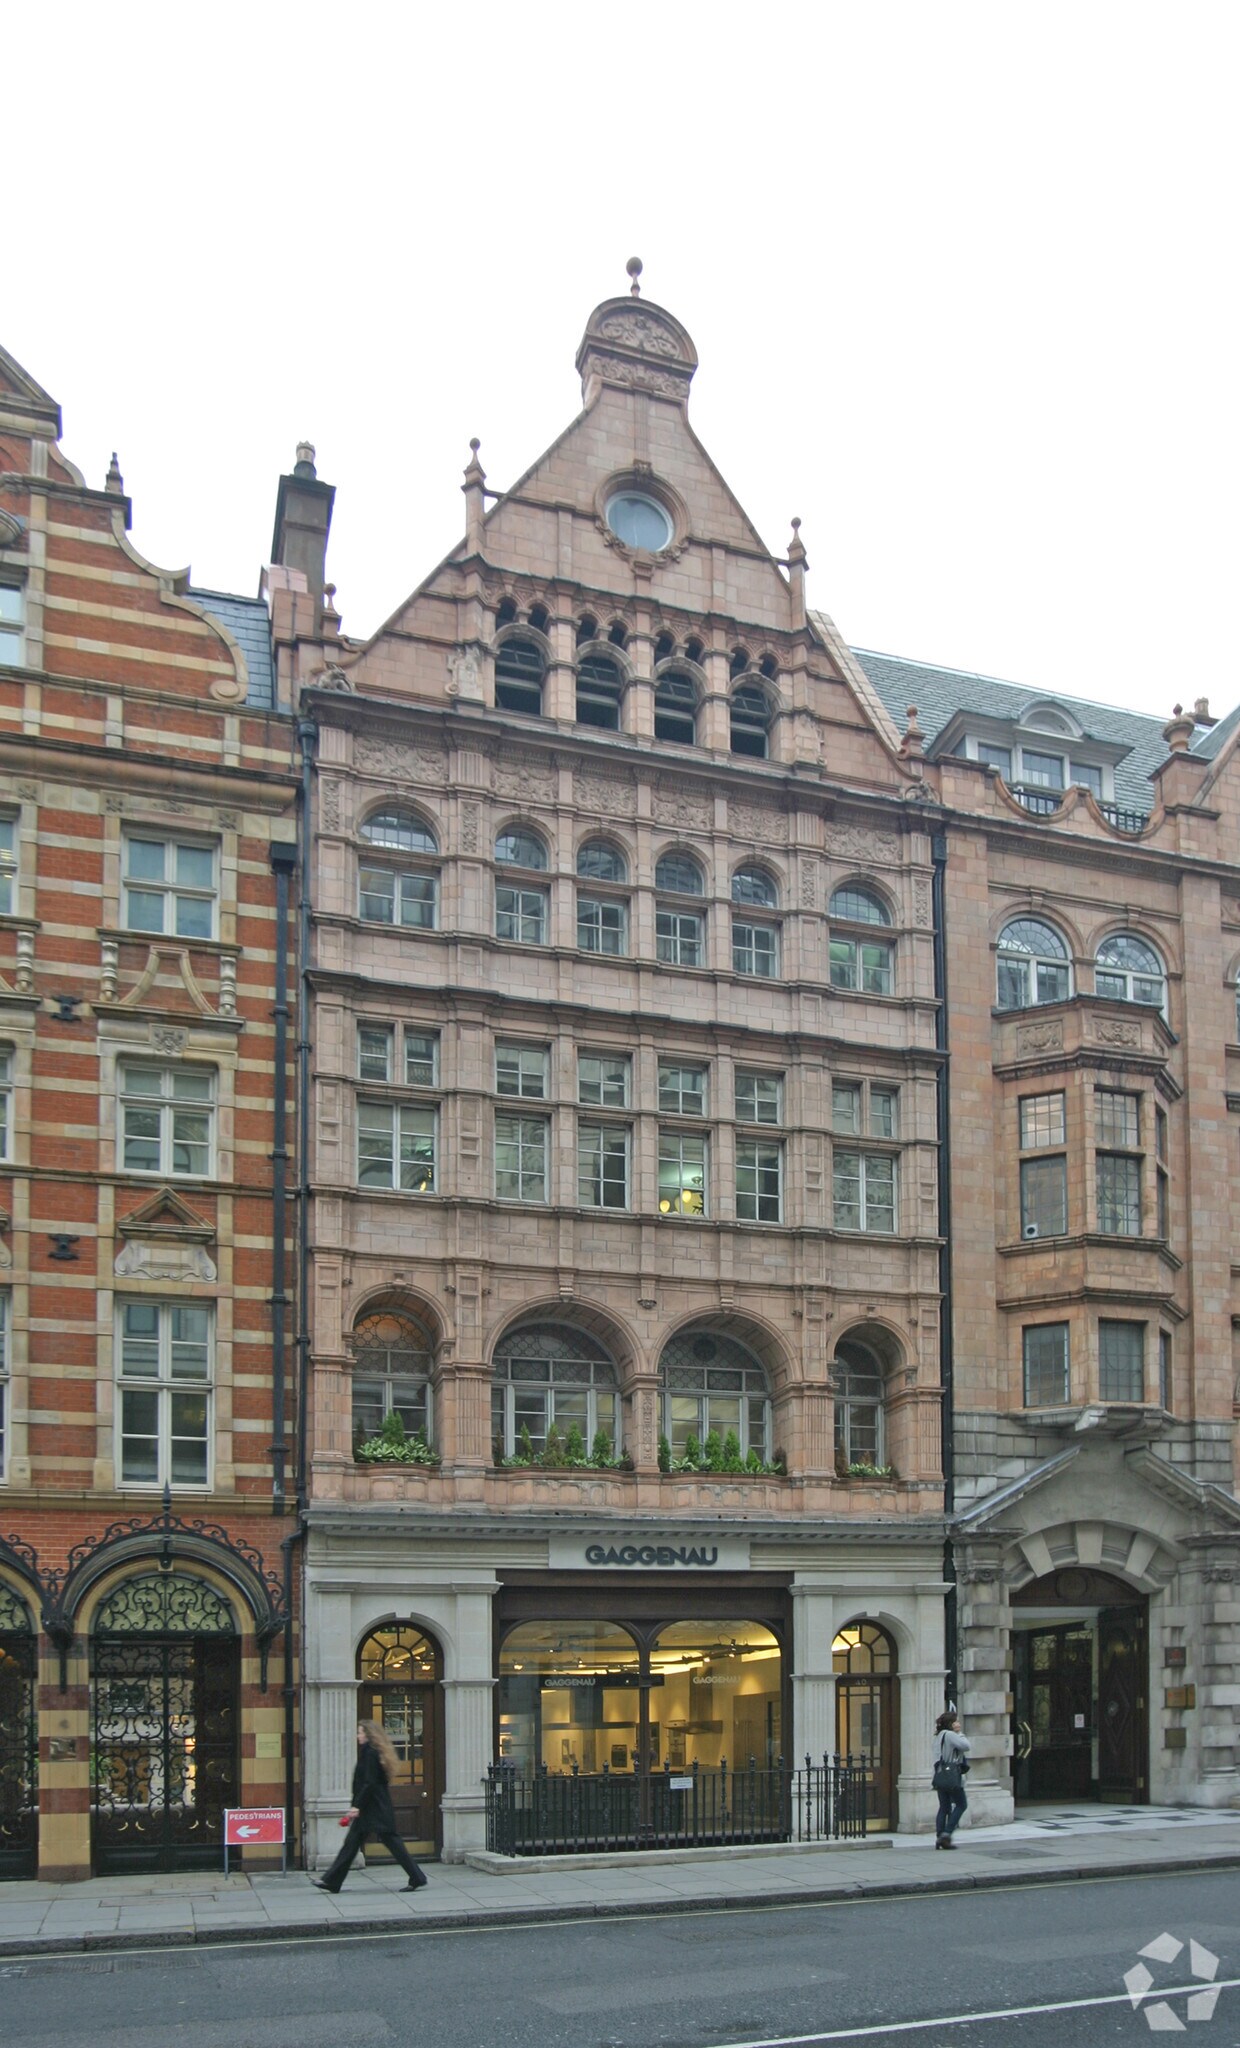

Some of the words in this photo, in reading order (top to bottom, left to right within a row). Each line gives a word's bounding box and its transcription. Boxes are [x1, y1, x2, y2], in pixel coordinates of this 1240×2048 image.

[585, 1544, 718, 1566] GAGGENAU
[544, 1678, 596, 1687] GAGGENAU
[692, 1675, 741, 1685] GAGGENAU
[229, 1812, 282, 1820] PEDESTRIANS
